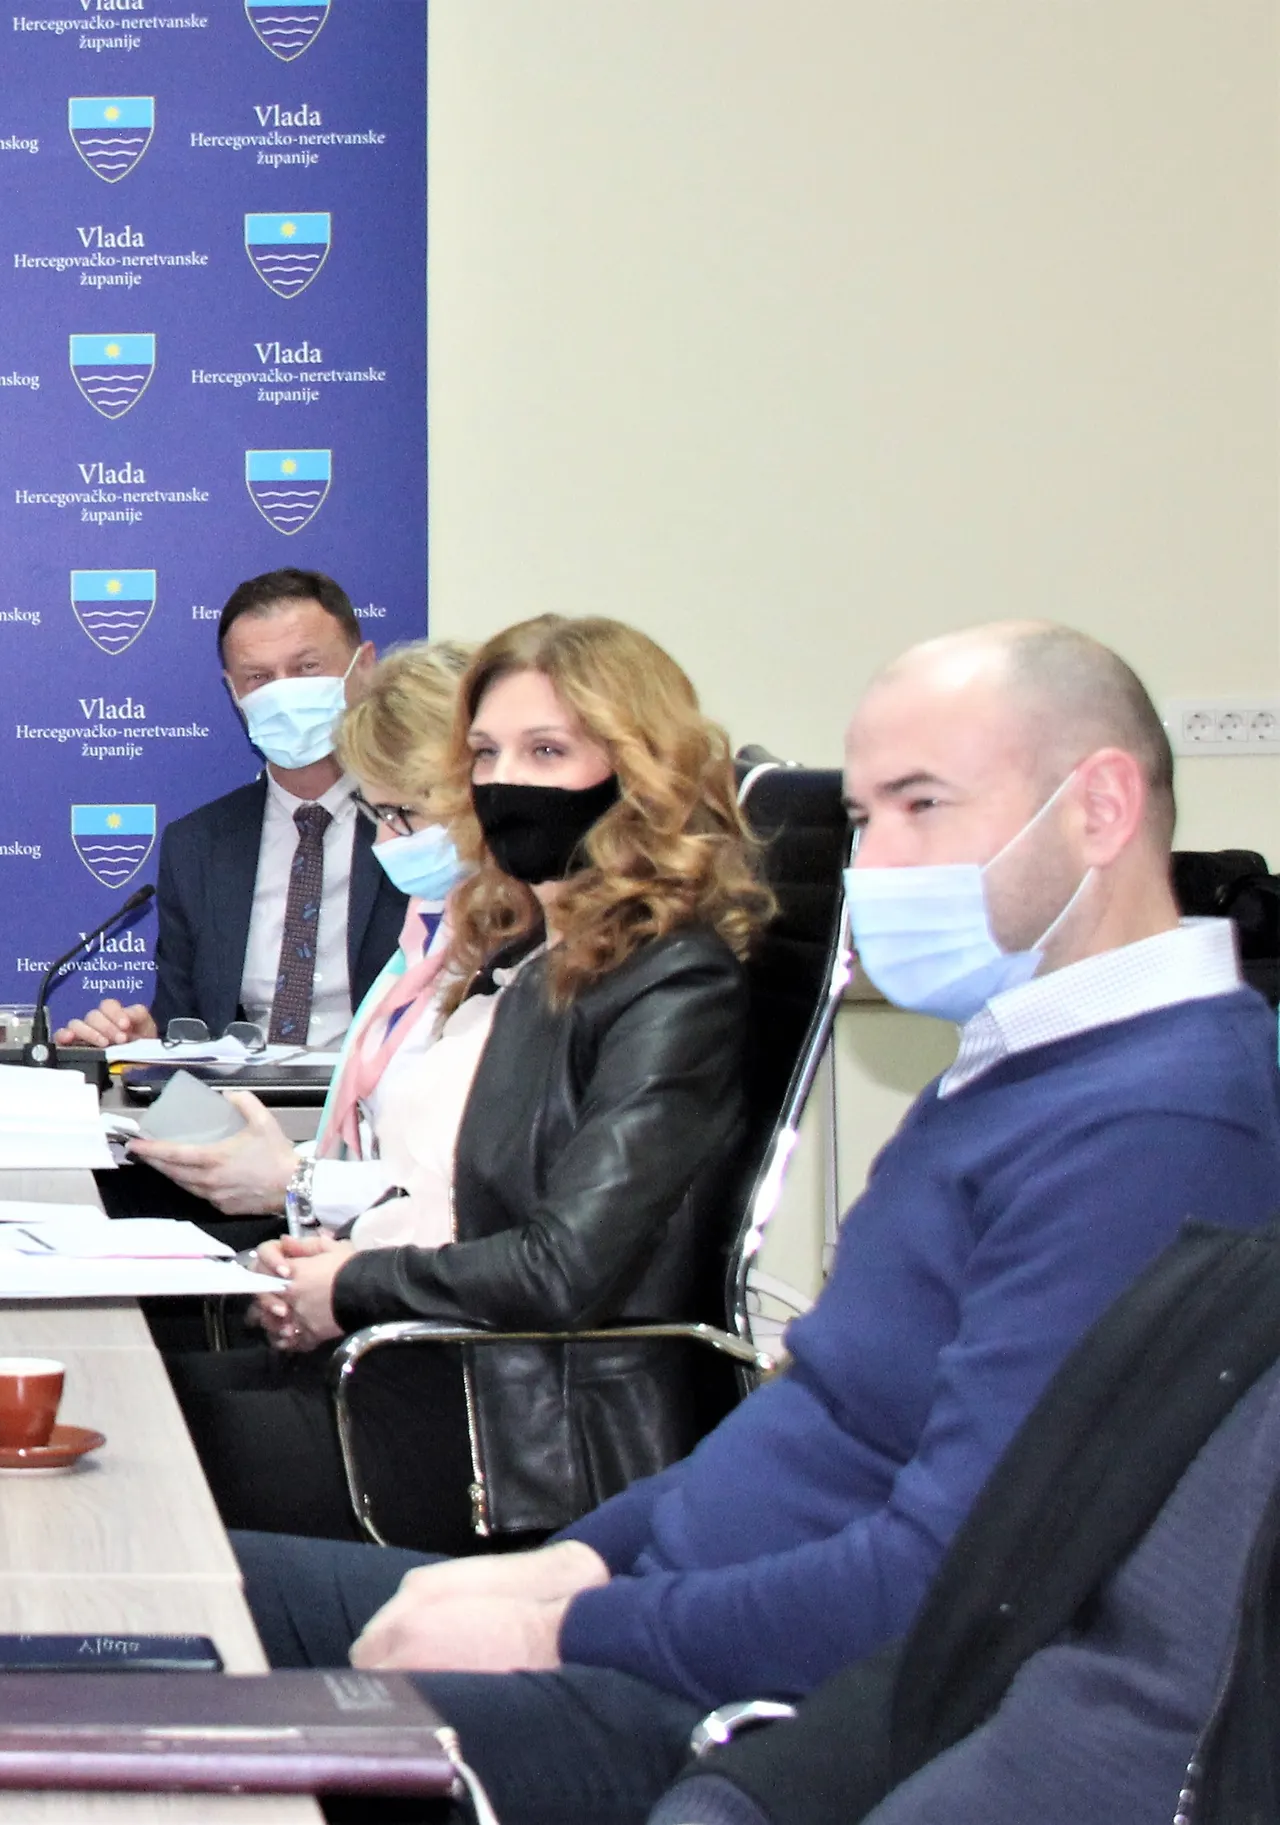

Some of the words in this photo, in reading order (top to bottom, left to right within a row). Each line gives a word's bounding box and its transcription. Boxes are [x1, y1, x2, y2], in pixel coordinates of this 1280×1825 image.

[12, 12, 209, 35] Hercegovačko-neretvanske
[78, 33, 141, 53] županije
[252, 102, 323, 127] Vlada
[190, 129, 387, 151] Hercegovačko-neretvanske
[256, 149, 320, 169] županije
[76, 224, 146, 248] Vlada
[13, 250, 209, 272] Hercegovačko-neretvanske
[79, 271, 142, 290] županije
[253, 339, 323, 365] Vlada
[191, 366, 387, 388] Hercegovačko-neretvanske
[257, 387, 320, 406] županije
[77, 461, 147, 485] Vlada
[15, 486, 210, 508] Hercegovačko-neretvanske
[80, 507, 143, 526] županije
[78, 696, 147, 720] Vlada
[15, 722, 210, 743] Hercegovačko-neretvanske
[81, 742, 144, 761] županije
[82, 975, 144, 994] županije
